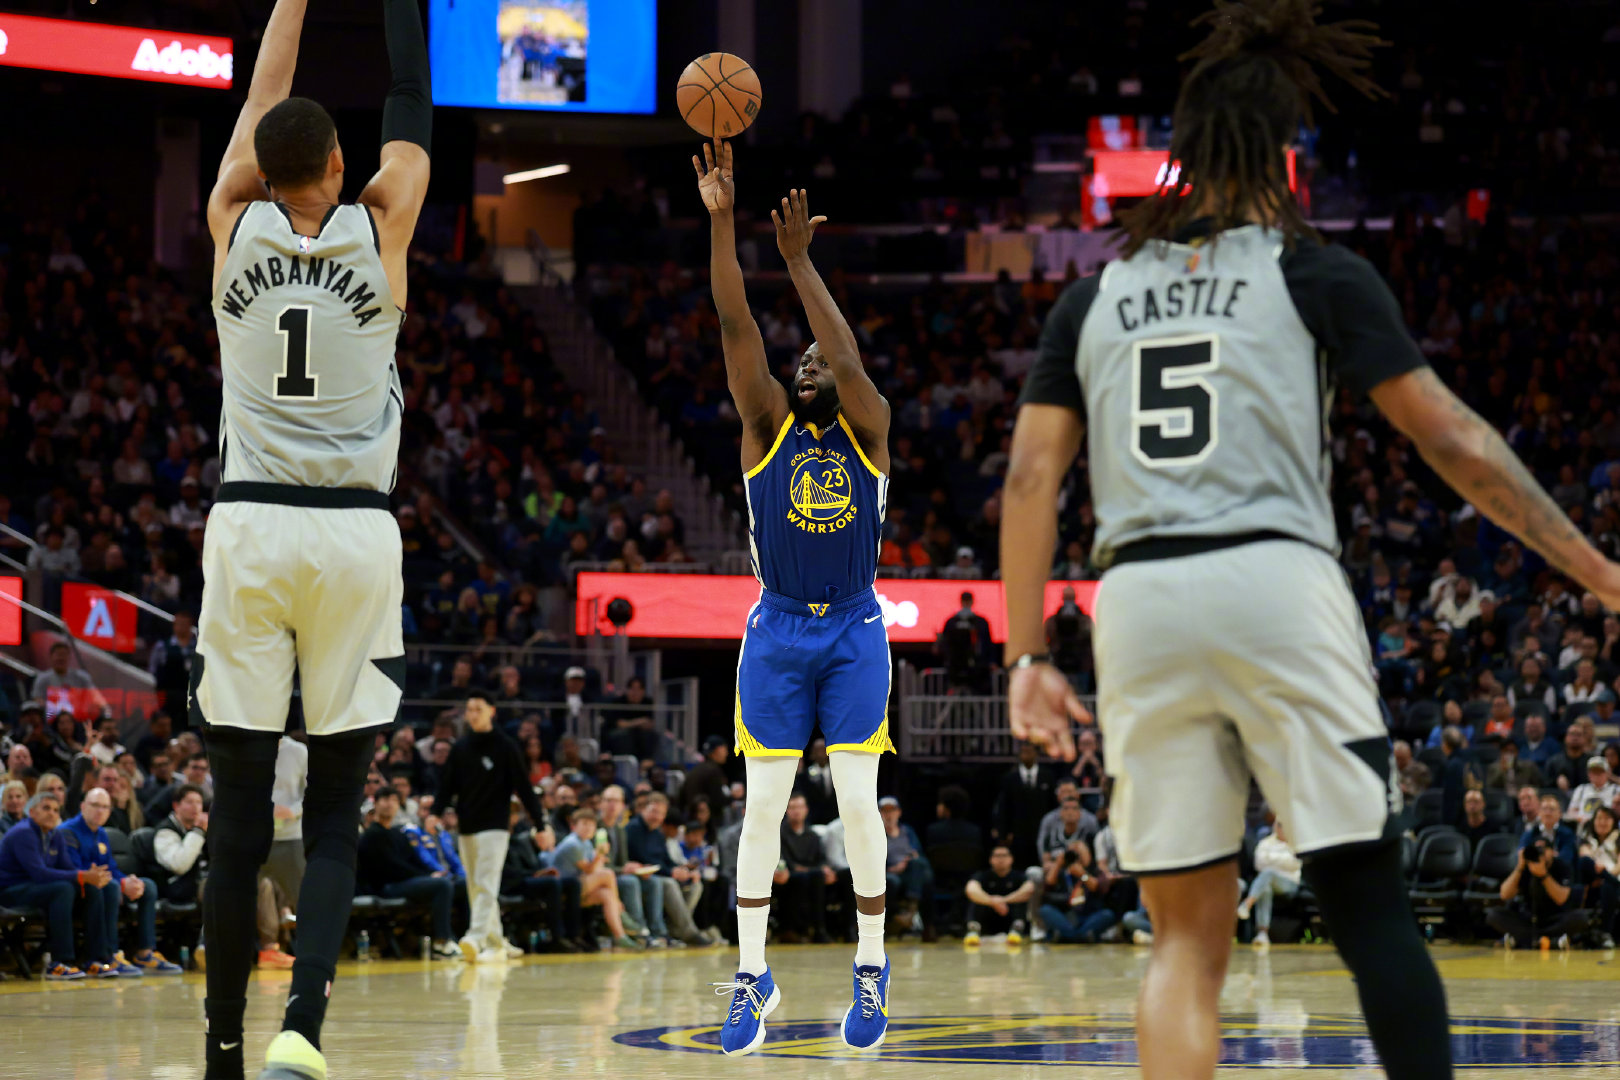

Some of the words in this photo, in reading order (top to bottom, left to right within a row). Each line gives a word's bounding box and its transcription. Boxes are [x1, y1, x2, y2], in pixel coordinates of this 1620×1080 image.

[222, 255, 382, 328] WEMBANYAMA
[1117, 278, 1248, 331] CASTLE
[273, 304, 319, 400] 1
[1130, 333, 1220, 469] 5
[821, 468, 845, 488] 23
[786, 504, 858, 534] WARRIORS
